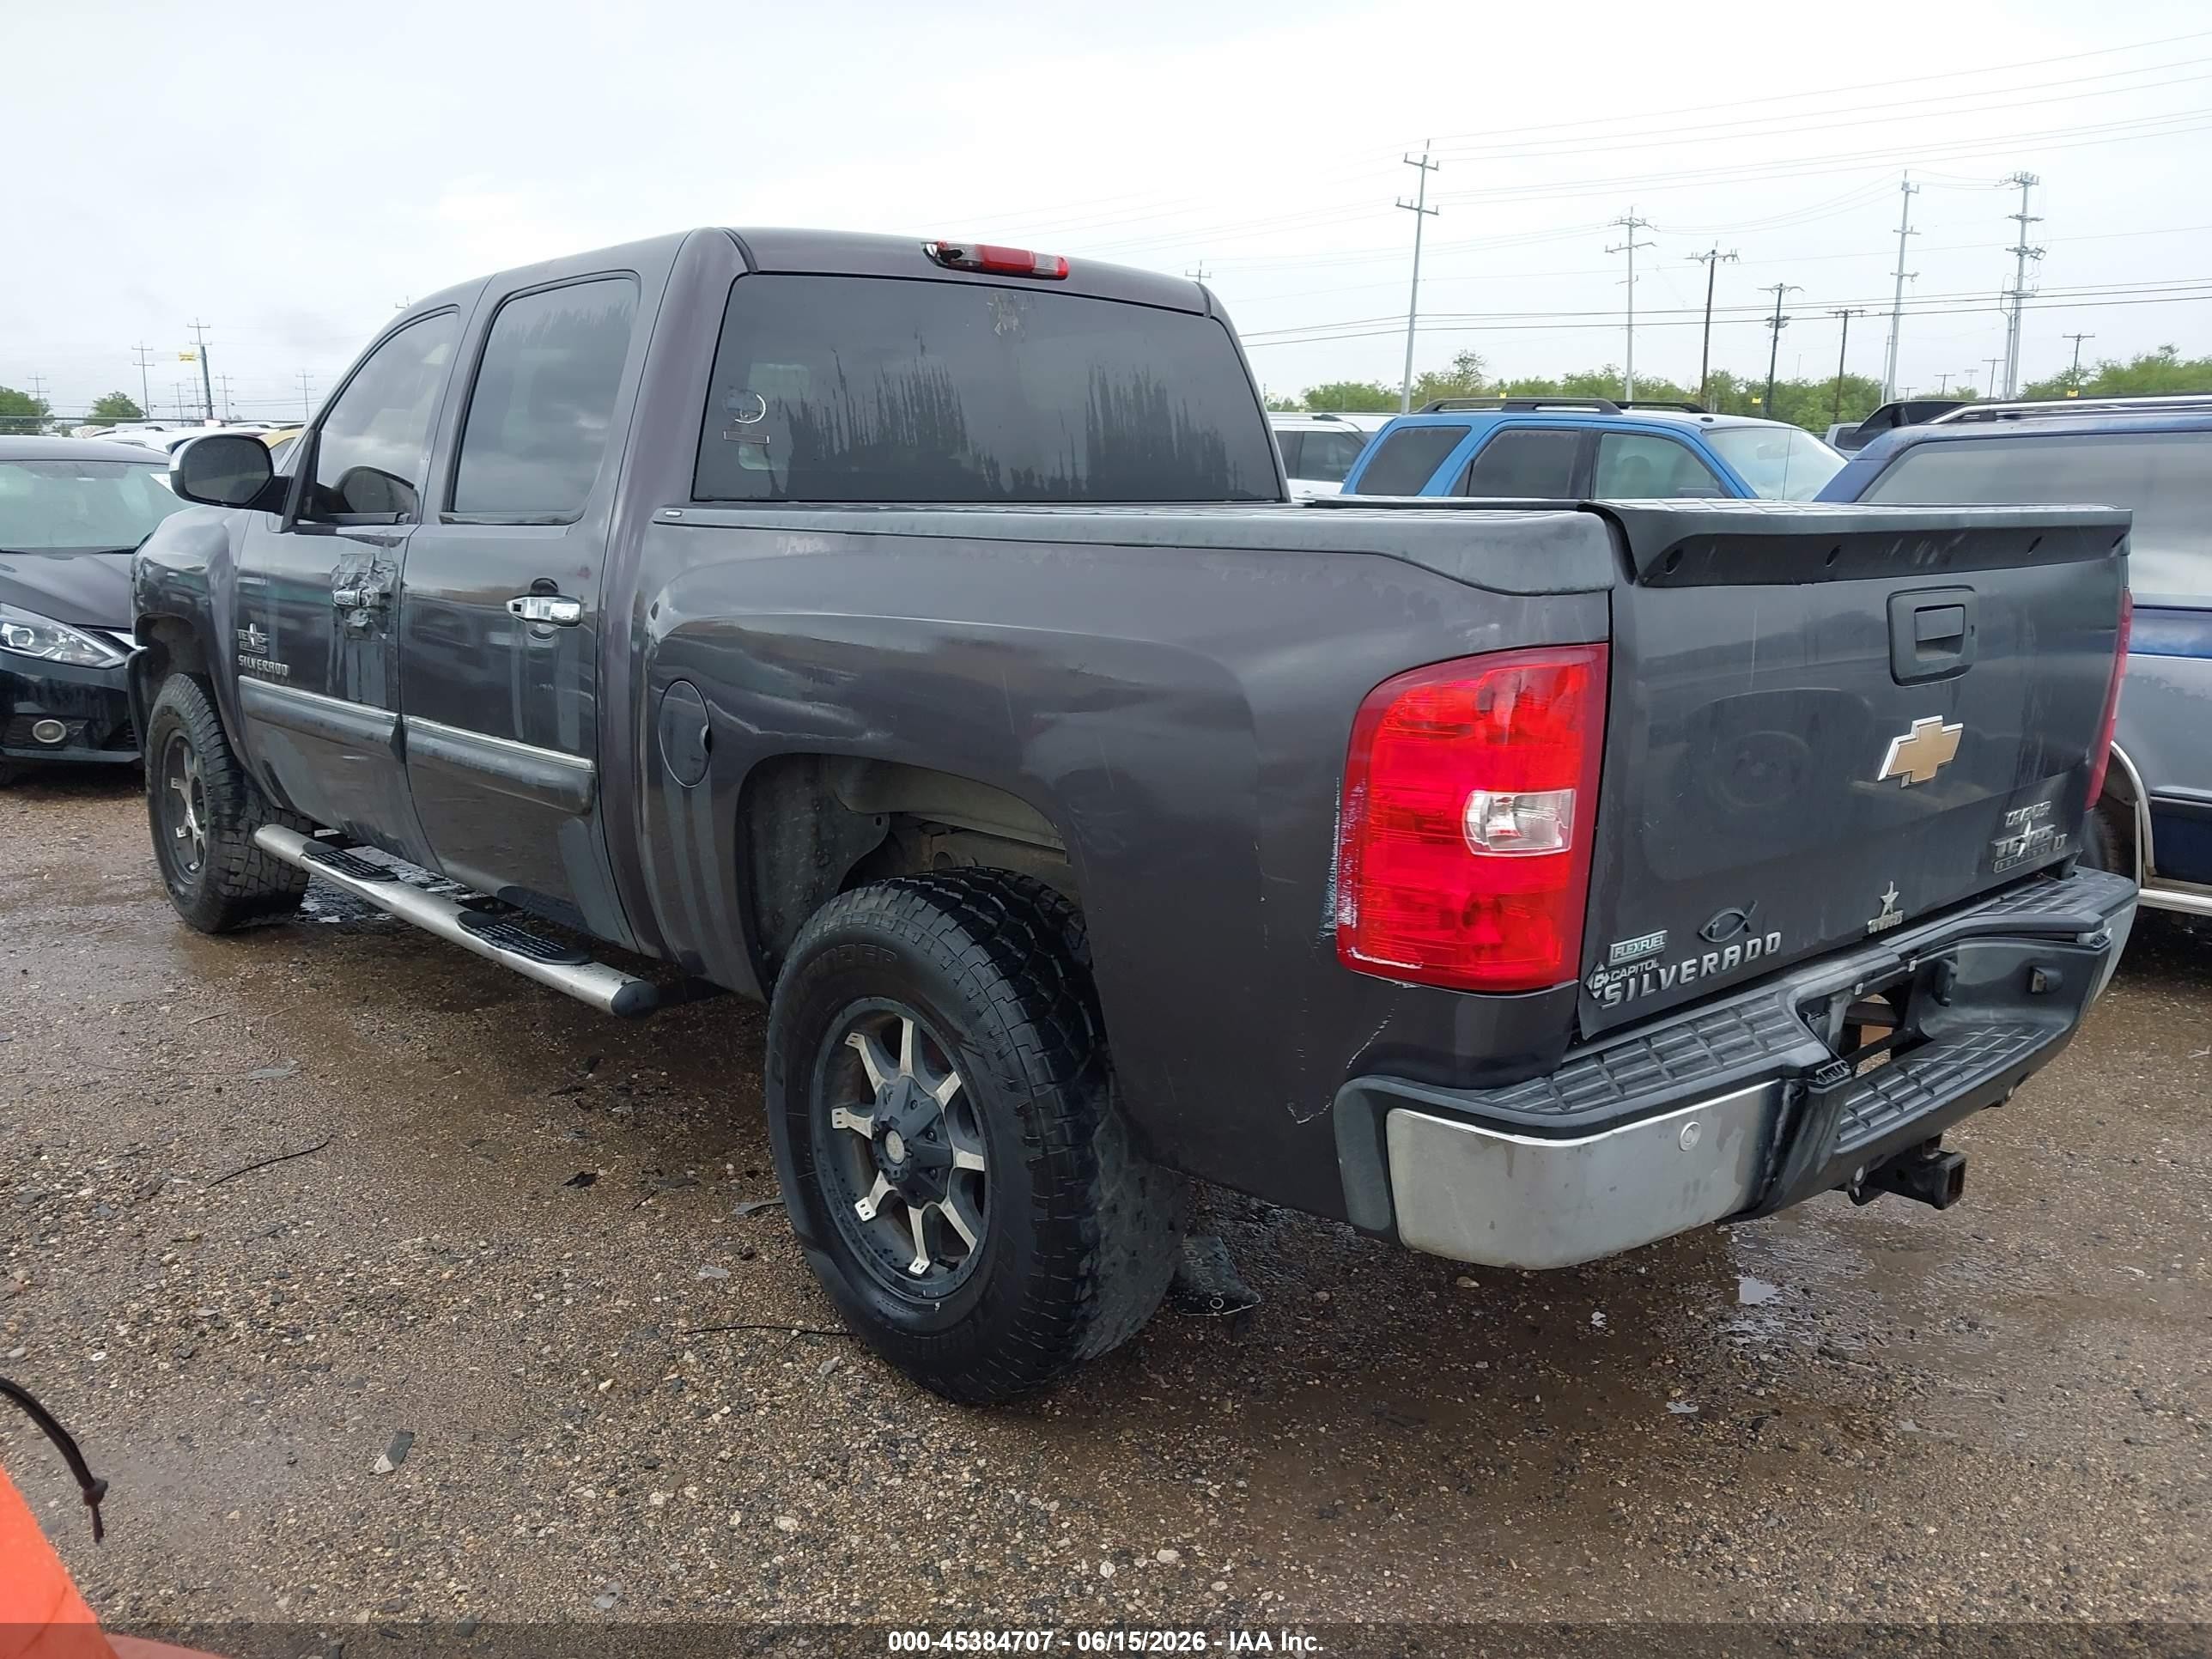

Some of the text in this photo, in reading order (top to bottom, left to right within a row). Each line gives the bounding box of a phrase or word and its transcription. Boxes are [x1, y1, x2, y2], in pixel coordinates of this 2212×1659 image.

[237, 654, 289, 677] SILVERADO
[1613, 934, 1667, 959] FLEXFUEL
[1601, 931, 1782, 1010] SILVERADO
[1610, 957, 1660, 981] CAPITOL
